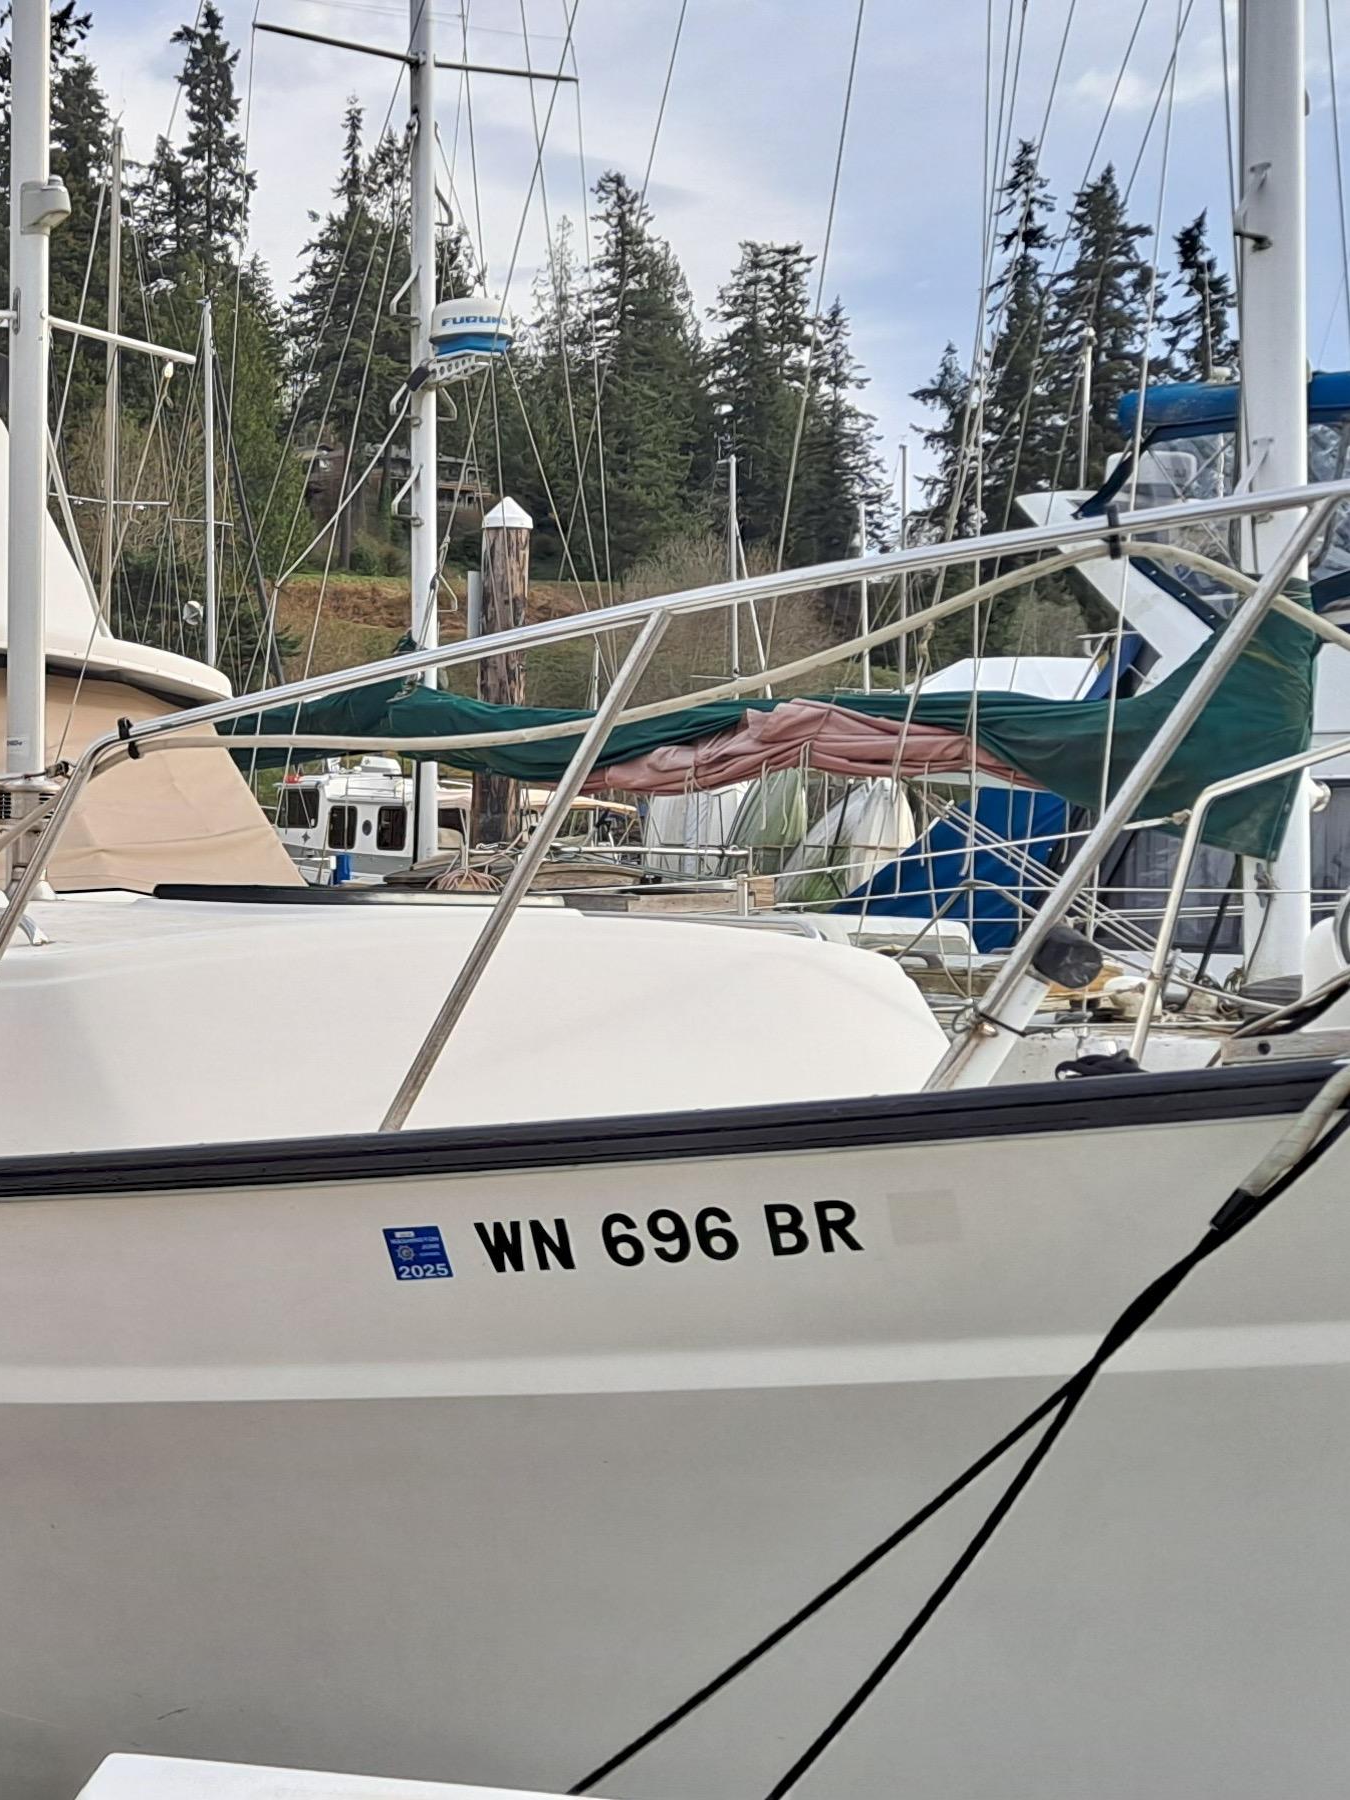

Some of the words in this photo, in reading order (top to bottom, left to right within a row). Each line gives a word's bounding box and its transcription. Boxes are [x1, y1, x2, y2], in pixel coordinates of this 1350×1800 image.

[473, 1218, 576, 1273] WN
[601, 1206, 739, 1267] 696
[763, 1199, 864, 1257] BR
[398, 1263, 449, 1279] 2025
